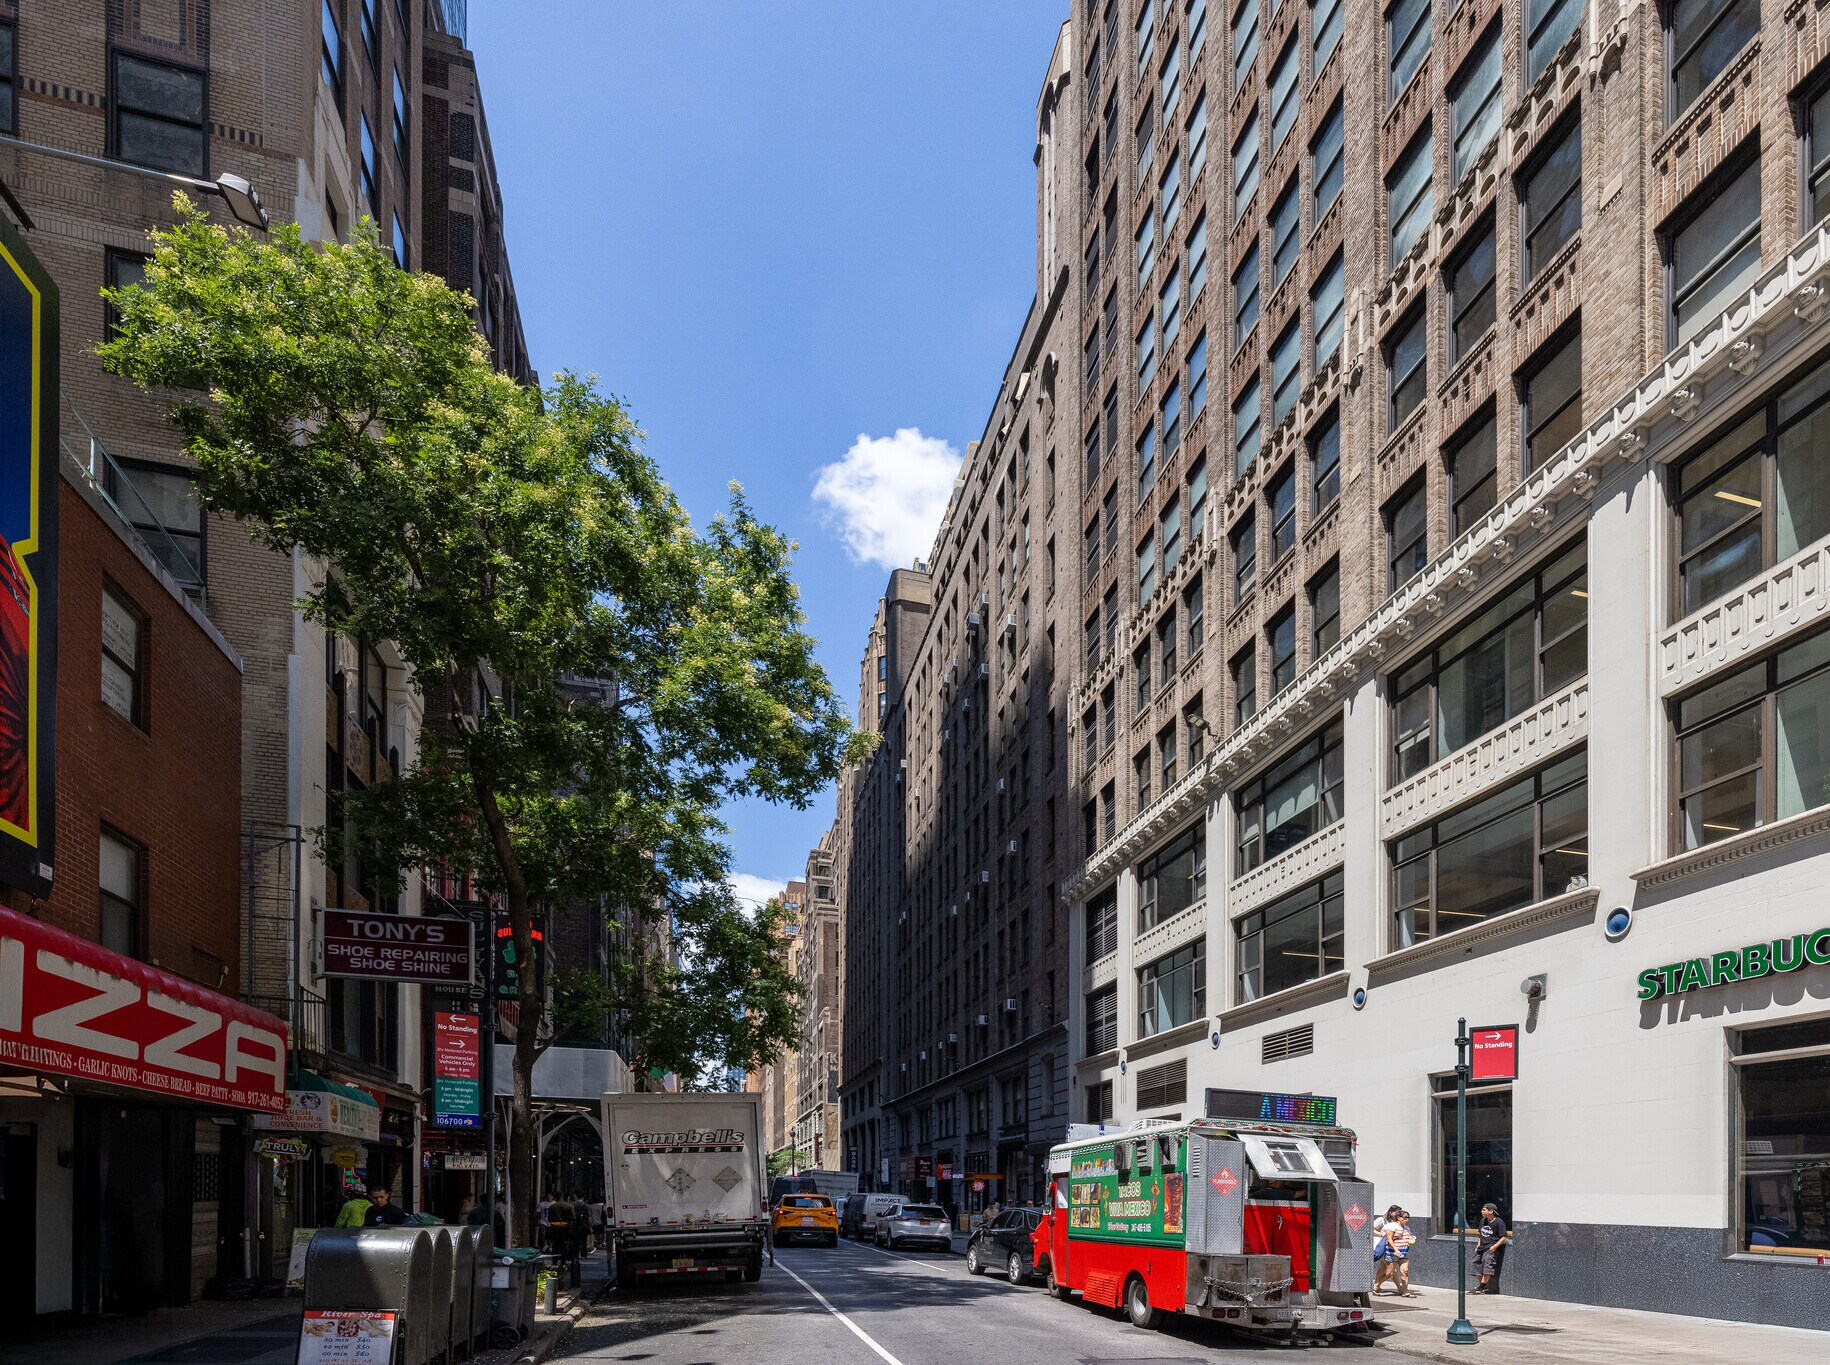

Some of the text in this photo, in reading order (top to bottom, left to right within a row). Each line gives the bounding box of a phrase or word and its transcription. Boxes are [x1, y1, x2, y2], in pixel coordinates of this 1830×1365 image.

[346, 920, 444, 942] TONY'S
[328, 944, 468, 964] SHOE REPAIRING
[350, 958, 450, 974] SHOE SHINE
[1636, 928, 1830, 1000] STARBUC
[435, 986, 468, 994] HOUSE
[449, 1025, 477, 1034] Standing
[78, 1056, 110, 1076] GARLIC
[111, 1064, 137, 1081] KNOTS
[142, 1071, 169, 1088] CHEESE
[170, 1076, 191, 1092] BREAD
[196, 1082, 211, 1097] BEEF
[211, 1086, 228, 1100] PATTY
[231, 1090, 246, 1103] SODA
[247, 1091, 284, 1110] 917-261-4052
[1276, 1098, 1334, 1121] MEXICO
[622, 1129, 745, 1146] Campbell's
[266, 1141, 300, 1152] TRULY
[1118, 1181, 1142, 1198] TACOS
[1109, 1200, 1151, 1216] VIVA MEXICO
[360, 1312, 382, 1320] Spa
